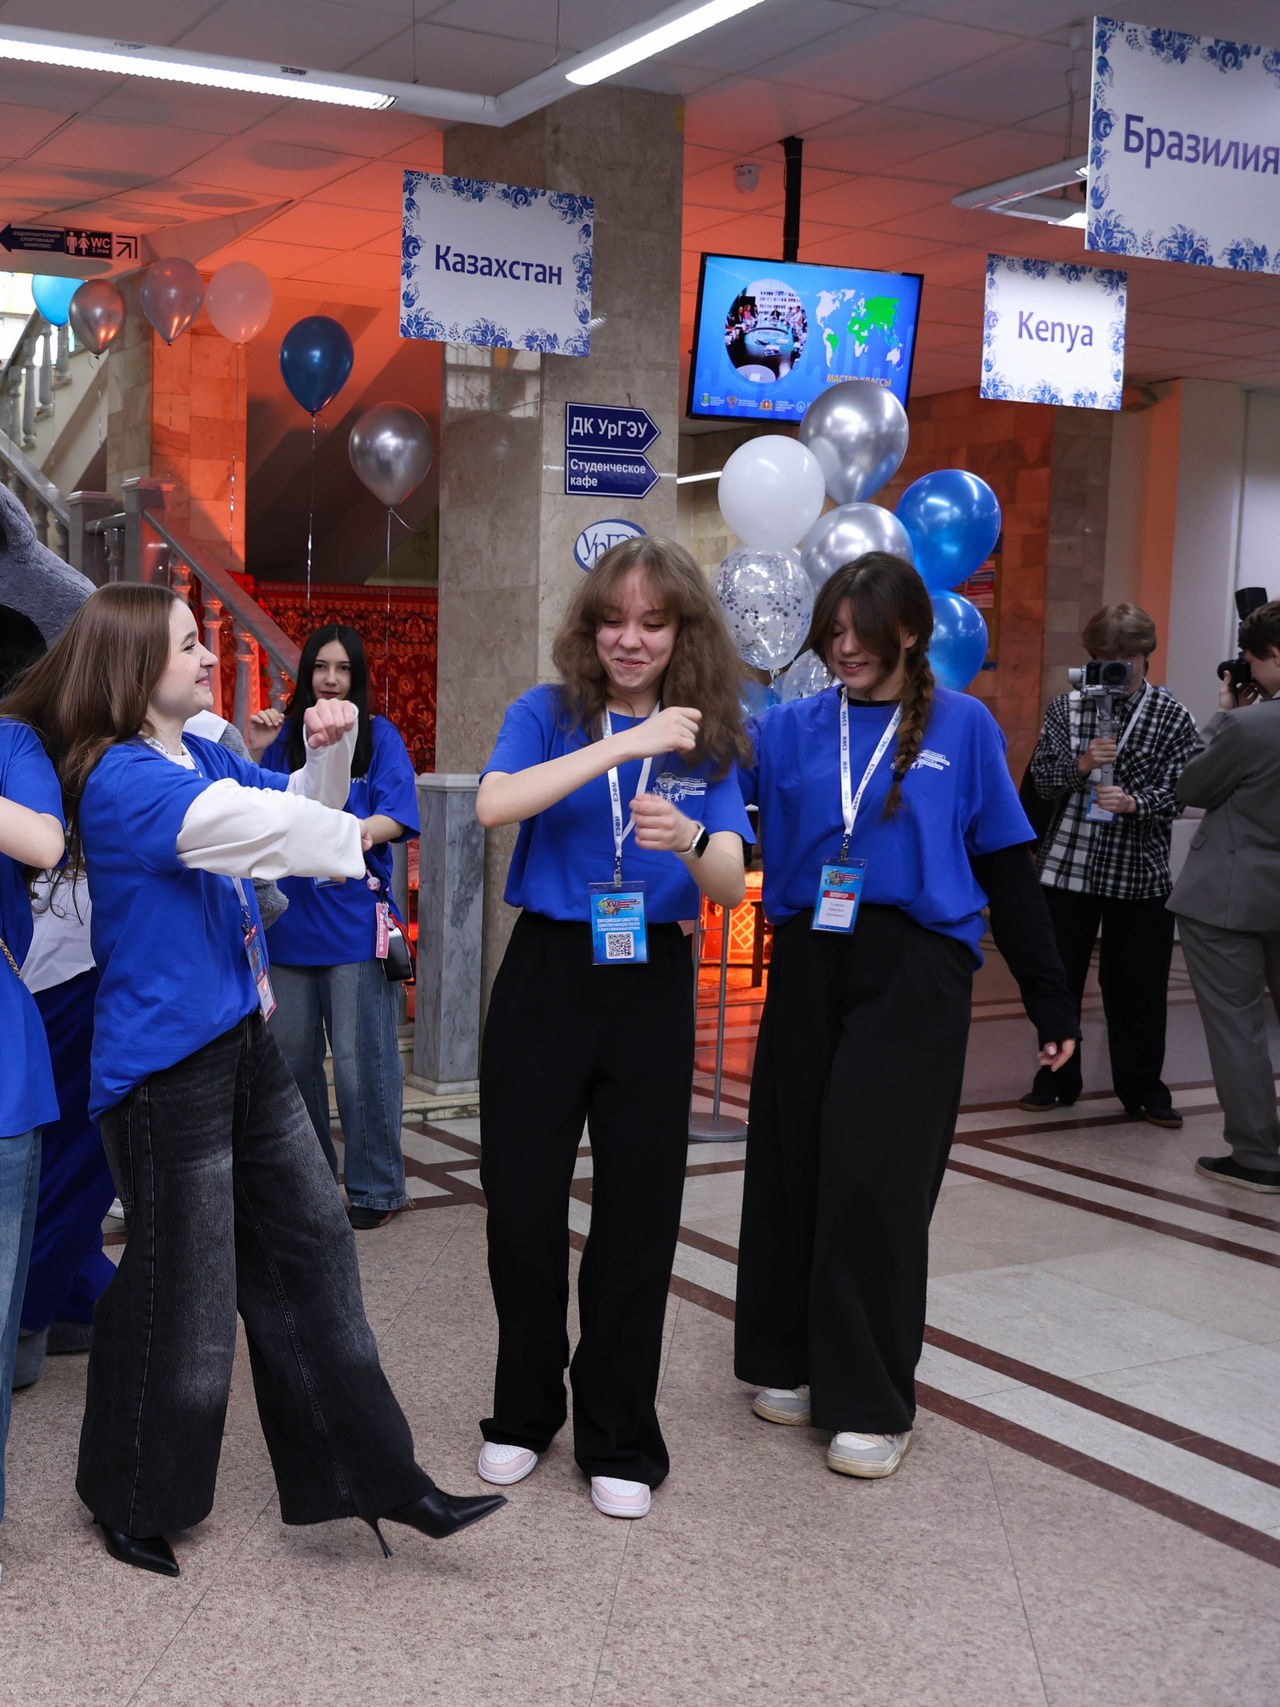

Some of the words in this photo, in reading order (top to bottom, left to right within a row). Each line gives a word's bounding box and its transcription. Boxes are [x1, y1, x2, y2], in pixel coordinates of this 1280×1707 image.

[1123, 113, 1280, 175] Бразилия
[91, 237, 111, 249] WC
[435, 244, 562, 285] Казахстан
[1018, 311, 1093, 353] Kenya
[571, 417, 594, 436] ДК
[598, 419, 648, 439] УрГЭУ
[570, 458, 646, 474] Студенческое
[570, 475, 598, 488] кафе
